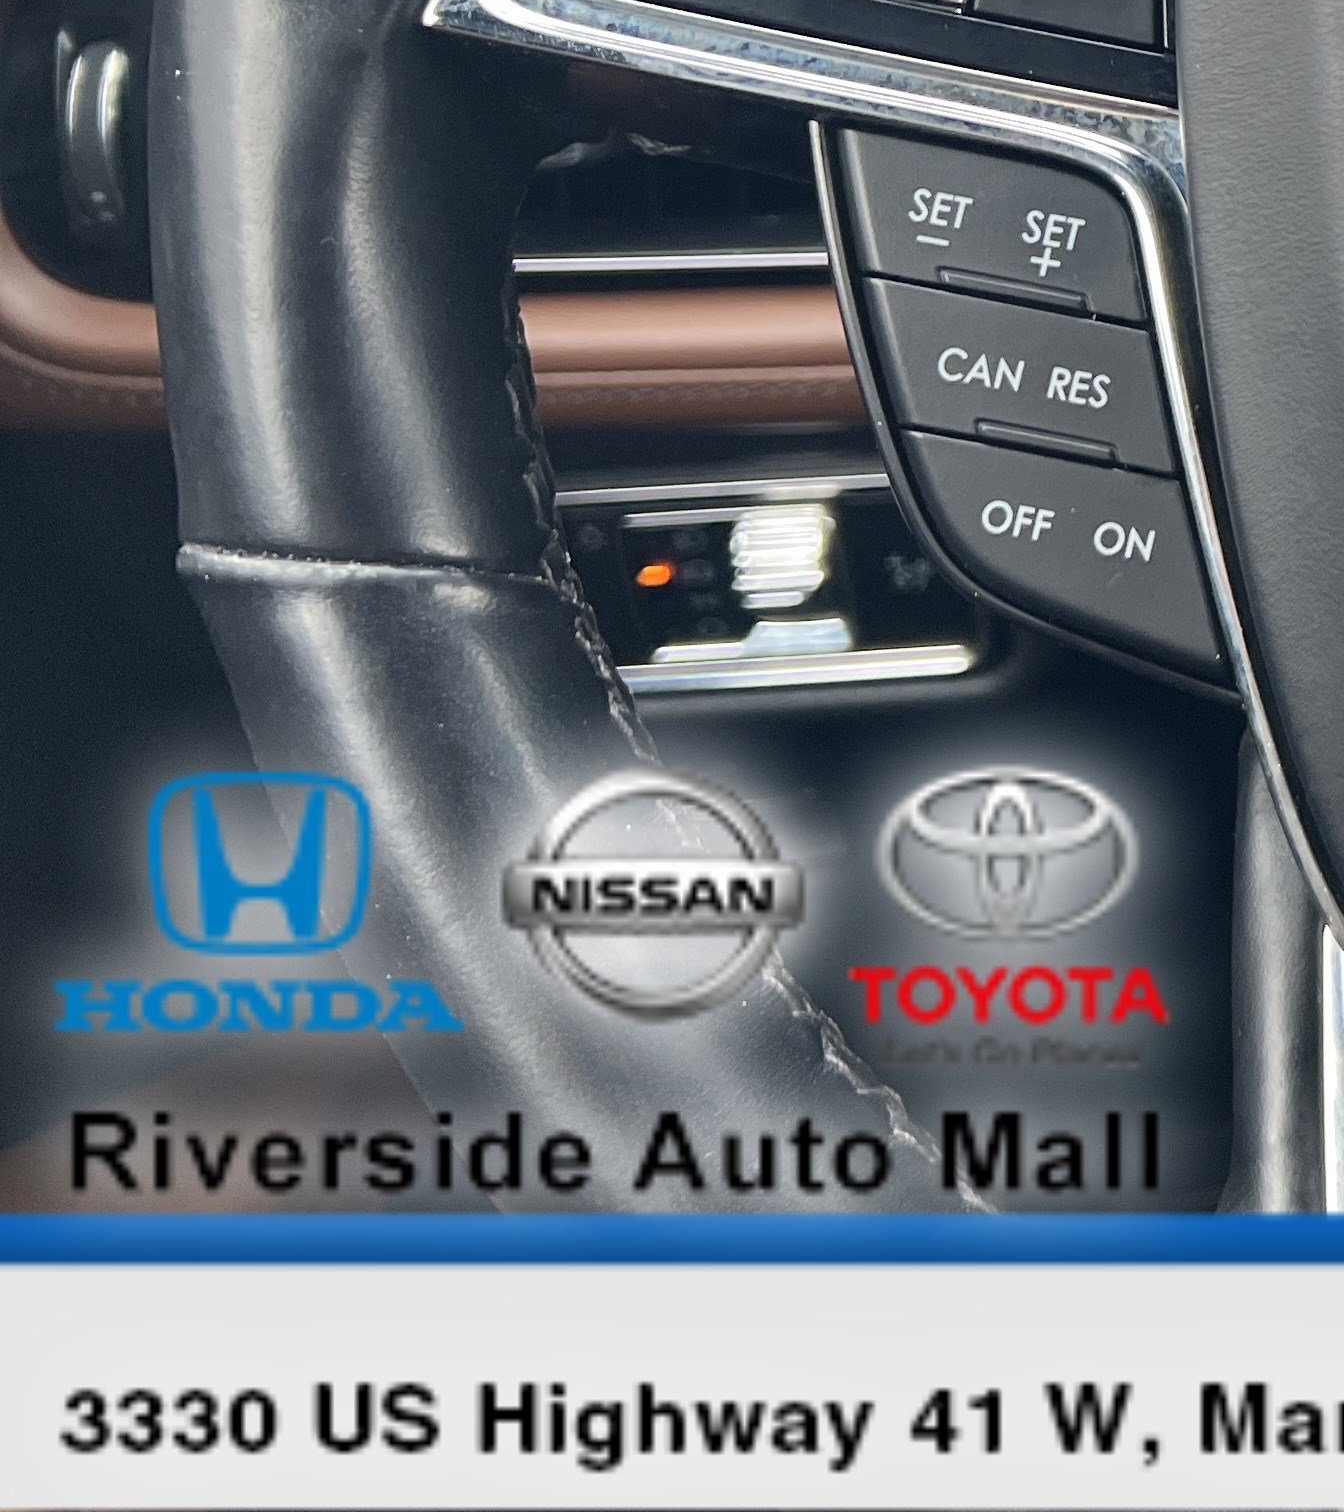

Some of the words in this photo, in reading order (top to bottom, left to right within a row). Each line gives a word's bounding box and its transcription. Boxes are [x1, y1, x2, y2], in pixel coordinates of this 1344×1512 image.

[908, 187, 974, 232] SET
[1021, 209, 1086, 252] SET
[937, 346, 1027, 393] CAN
[1046, 366, 1112, 409] RES
[980, 499, 1056, 542] OFF
[1092, 520, 1157, 563] ON
